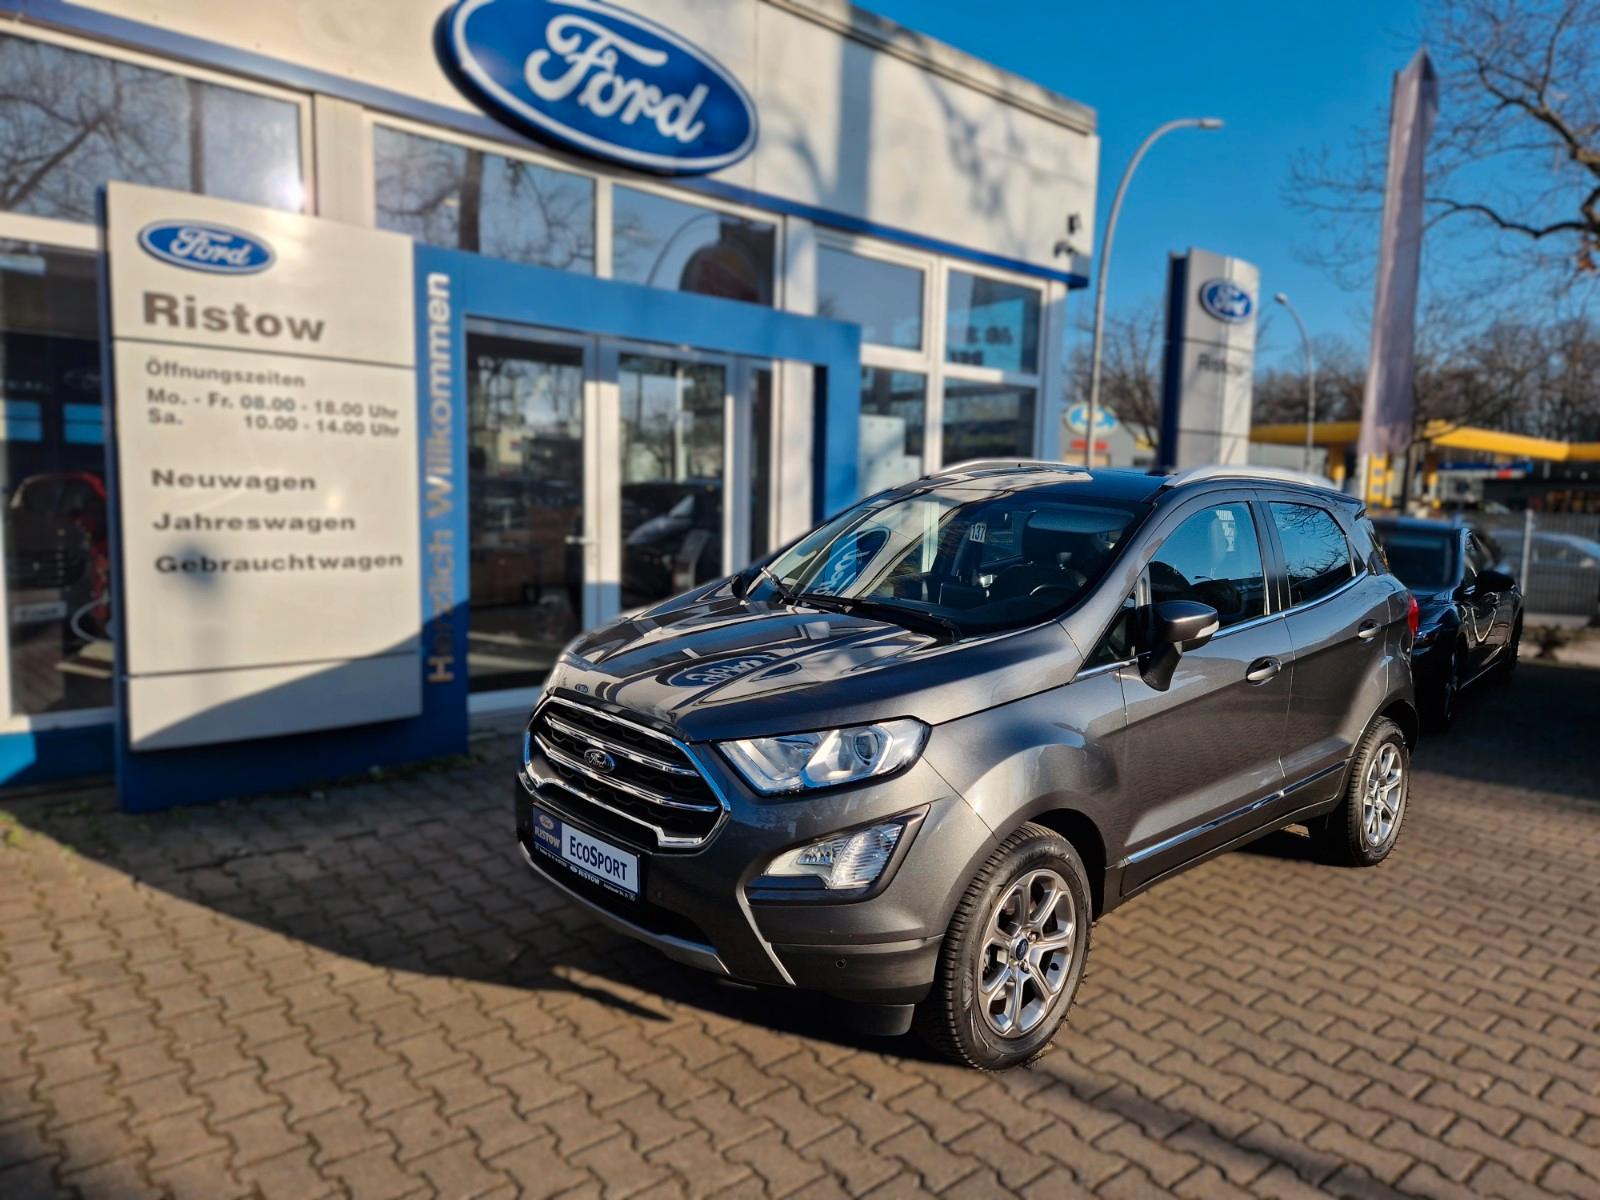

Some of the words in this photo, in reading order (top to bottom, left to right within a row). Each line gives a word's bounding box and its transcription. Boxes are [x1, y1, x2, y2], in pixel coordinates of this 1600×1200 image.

[523, 13, 711, 144] Ford
[169, 226, 251, 267] Ford
[142, 291, 326, 342] Ristow
[145, 359, 307, 388] Öffnungszeiten
[147, 388, 188, 406] Mo.
[207, 391, 234, 409] Fr.
[239, 394, 296, 412] 08.00
[315, 400, 364, 418] 18.00
[368, 404, 399, 420] Uhr
[425, 272, 455, 518] Willkommen
[147, 407, 184, 426] Sa.
[244, 414, 299, 432] 10.00
[317, 419, 366, 436] 14.00
[370, 423, 400, 438] Uhr
[150, 469, 317, 491] Neuwagen
[152, 513, 357, 533] Jahreswagen
[155, 552, 404, 574] Gebrauchtwagen
